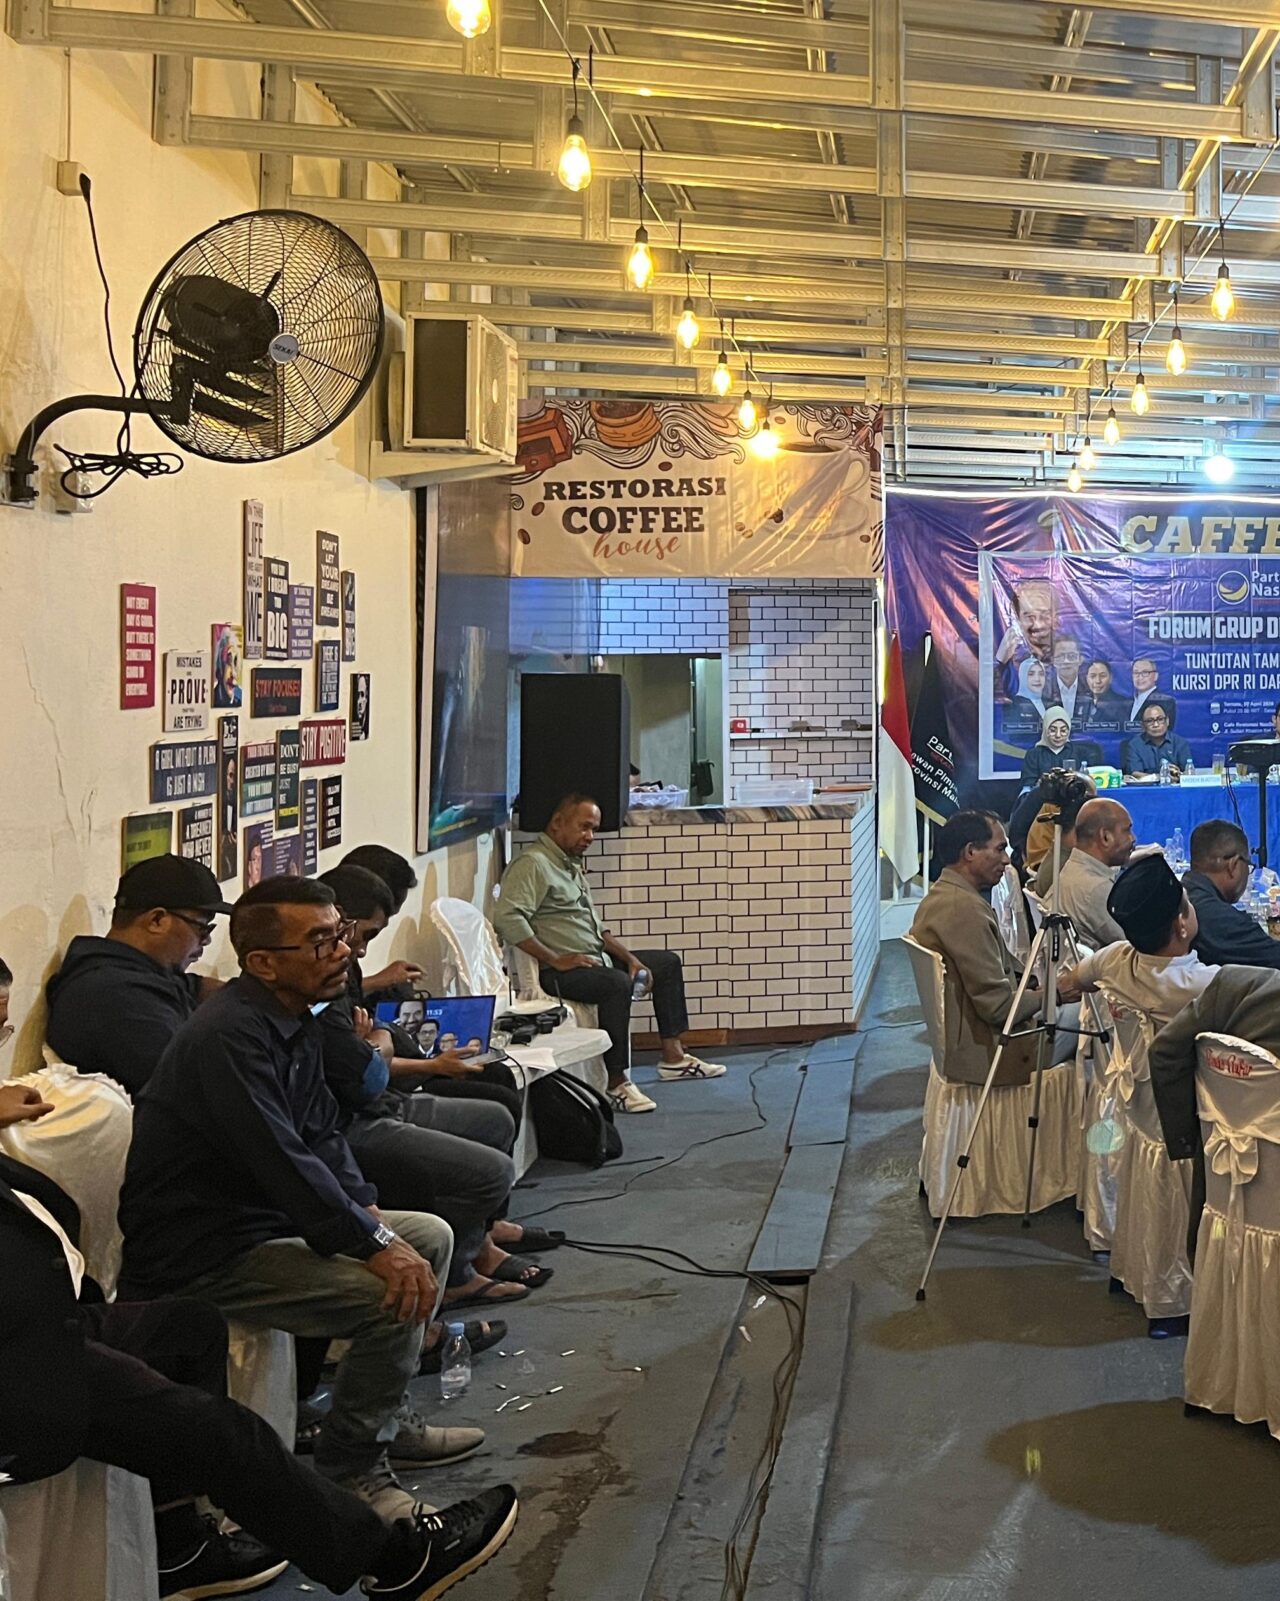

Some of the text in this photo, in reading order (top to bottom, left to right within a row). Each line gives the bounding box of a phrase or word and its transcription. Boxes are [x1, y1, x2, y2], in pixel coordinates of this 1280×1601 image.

[543, 477, 726, 501] RESTORASI
[562, 506, 705, 535] COFFEE
[248, 522, 263, 559] LIFE
[321, 539, 338, 553] DON'T
[593, 530, 681, 560] house
[325, 553, 334, 564] LET
[321, 564, 338, 580] YOUR
[248, 575, 263, 589] WHAT
[321, 579, 339, 592] DREAMS
[326, 593, 334, 605] BE
[247, 592, 262, 642] WE
[267, 611, 288, 649] BIG
[1149, 616, 1211, 639] FORUM
[1215, 616, 1264, 639] GRUP
[176, 657, 202, 668] MISTAKES
[1185, 652, 1250, 669] TUNTUTAN
[256, 680, 272, 698] STAY
[1173, 674, 1210, 690] KURSI
[1214, 674, 1238, 690] DPR
[1243, 674, 1255, 689] RI
[170, 679, 206, 705] PROVE
[174, 715, 202, 729] ARE TRYING
[280, 744, 299, 758] DON'T
[301, 726, 318, 762] STAY
[319, 725, 346, 760] POSITIVE
[280, 763, 299, 775] BE BUSY
[194, 836, 212, 857] NEVER
